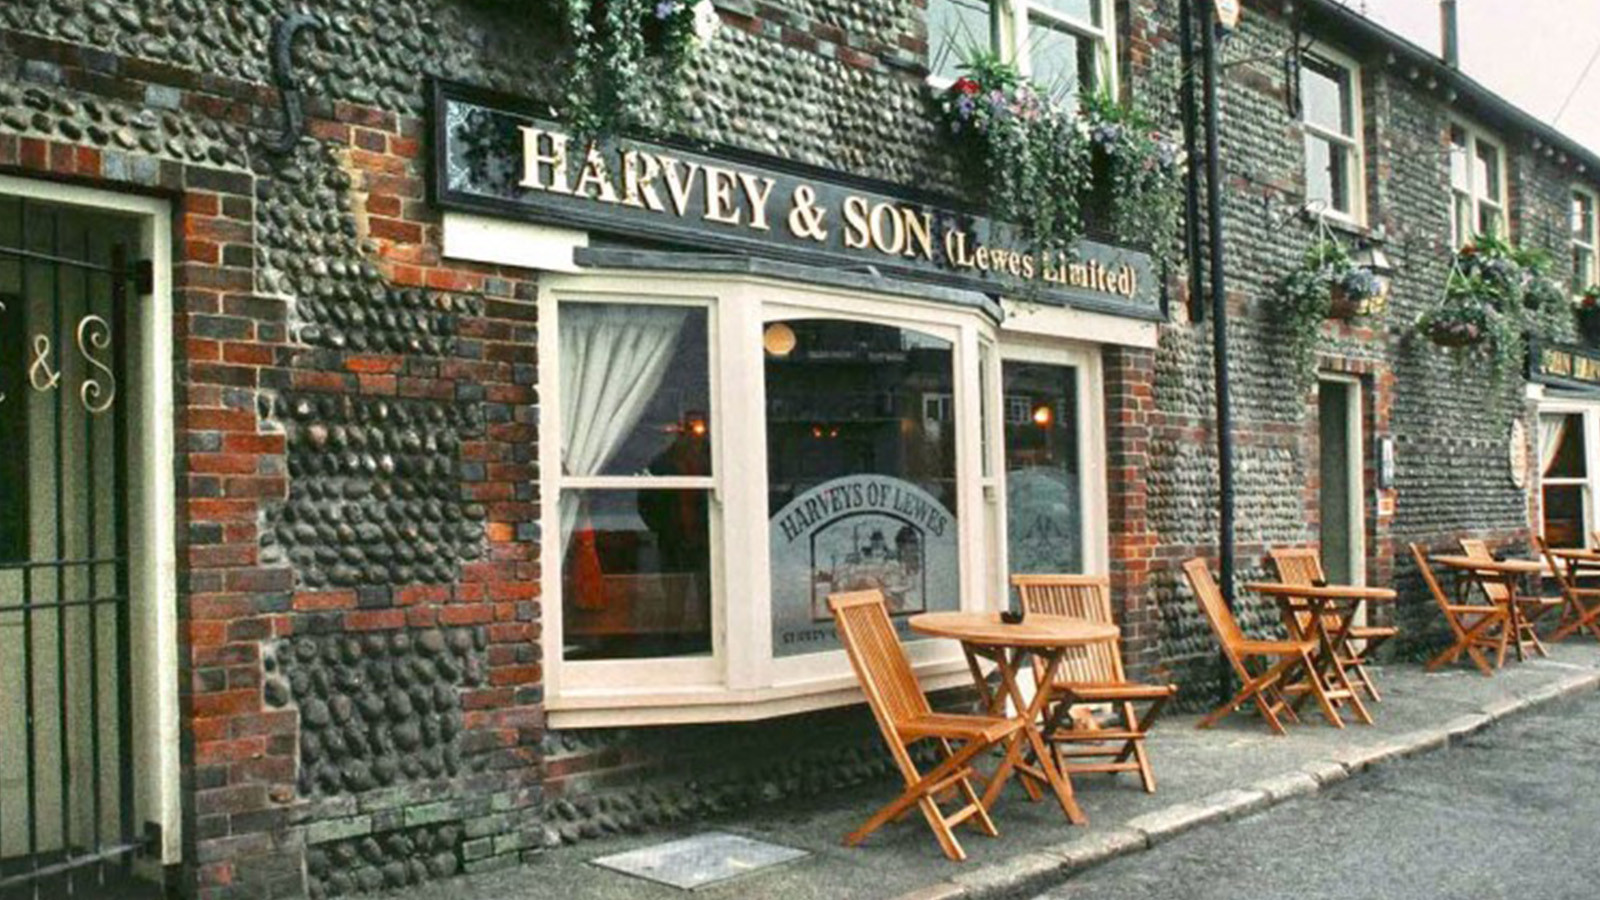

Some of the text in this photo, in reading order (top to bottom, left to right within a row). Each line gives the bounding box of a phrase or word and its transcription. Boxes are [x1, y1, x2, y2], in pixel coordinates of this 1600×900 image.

[516, 125, 1136, 299] HARVEY & SON (Lewes Limited)
[779, 481, 949, 544] HARVEYS OF LEWES
